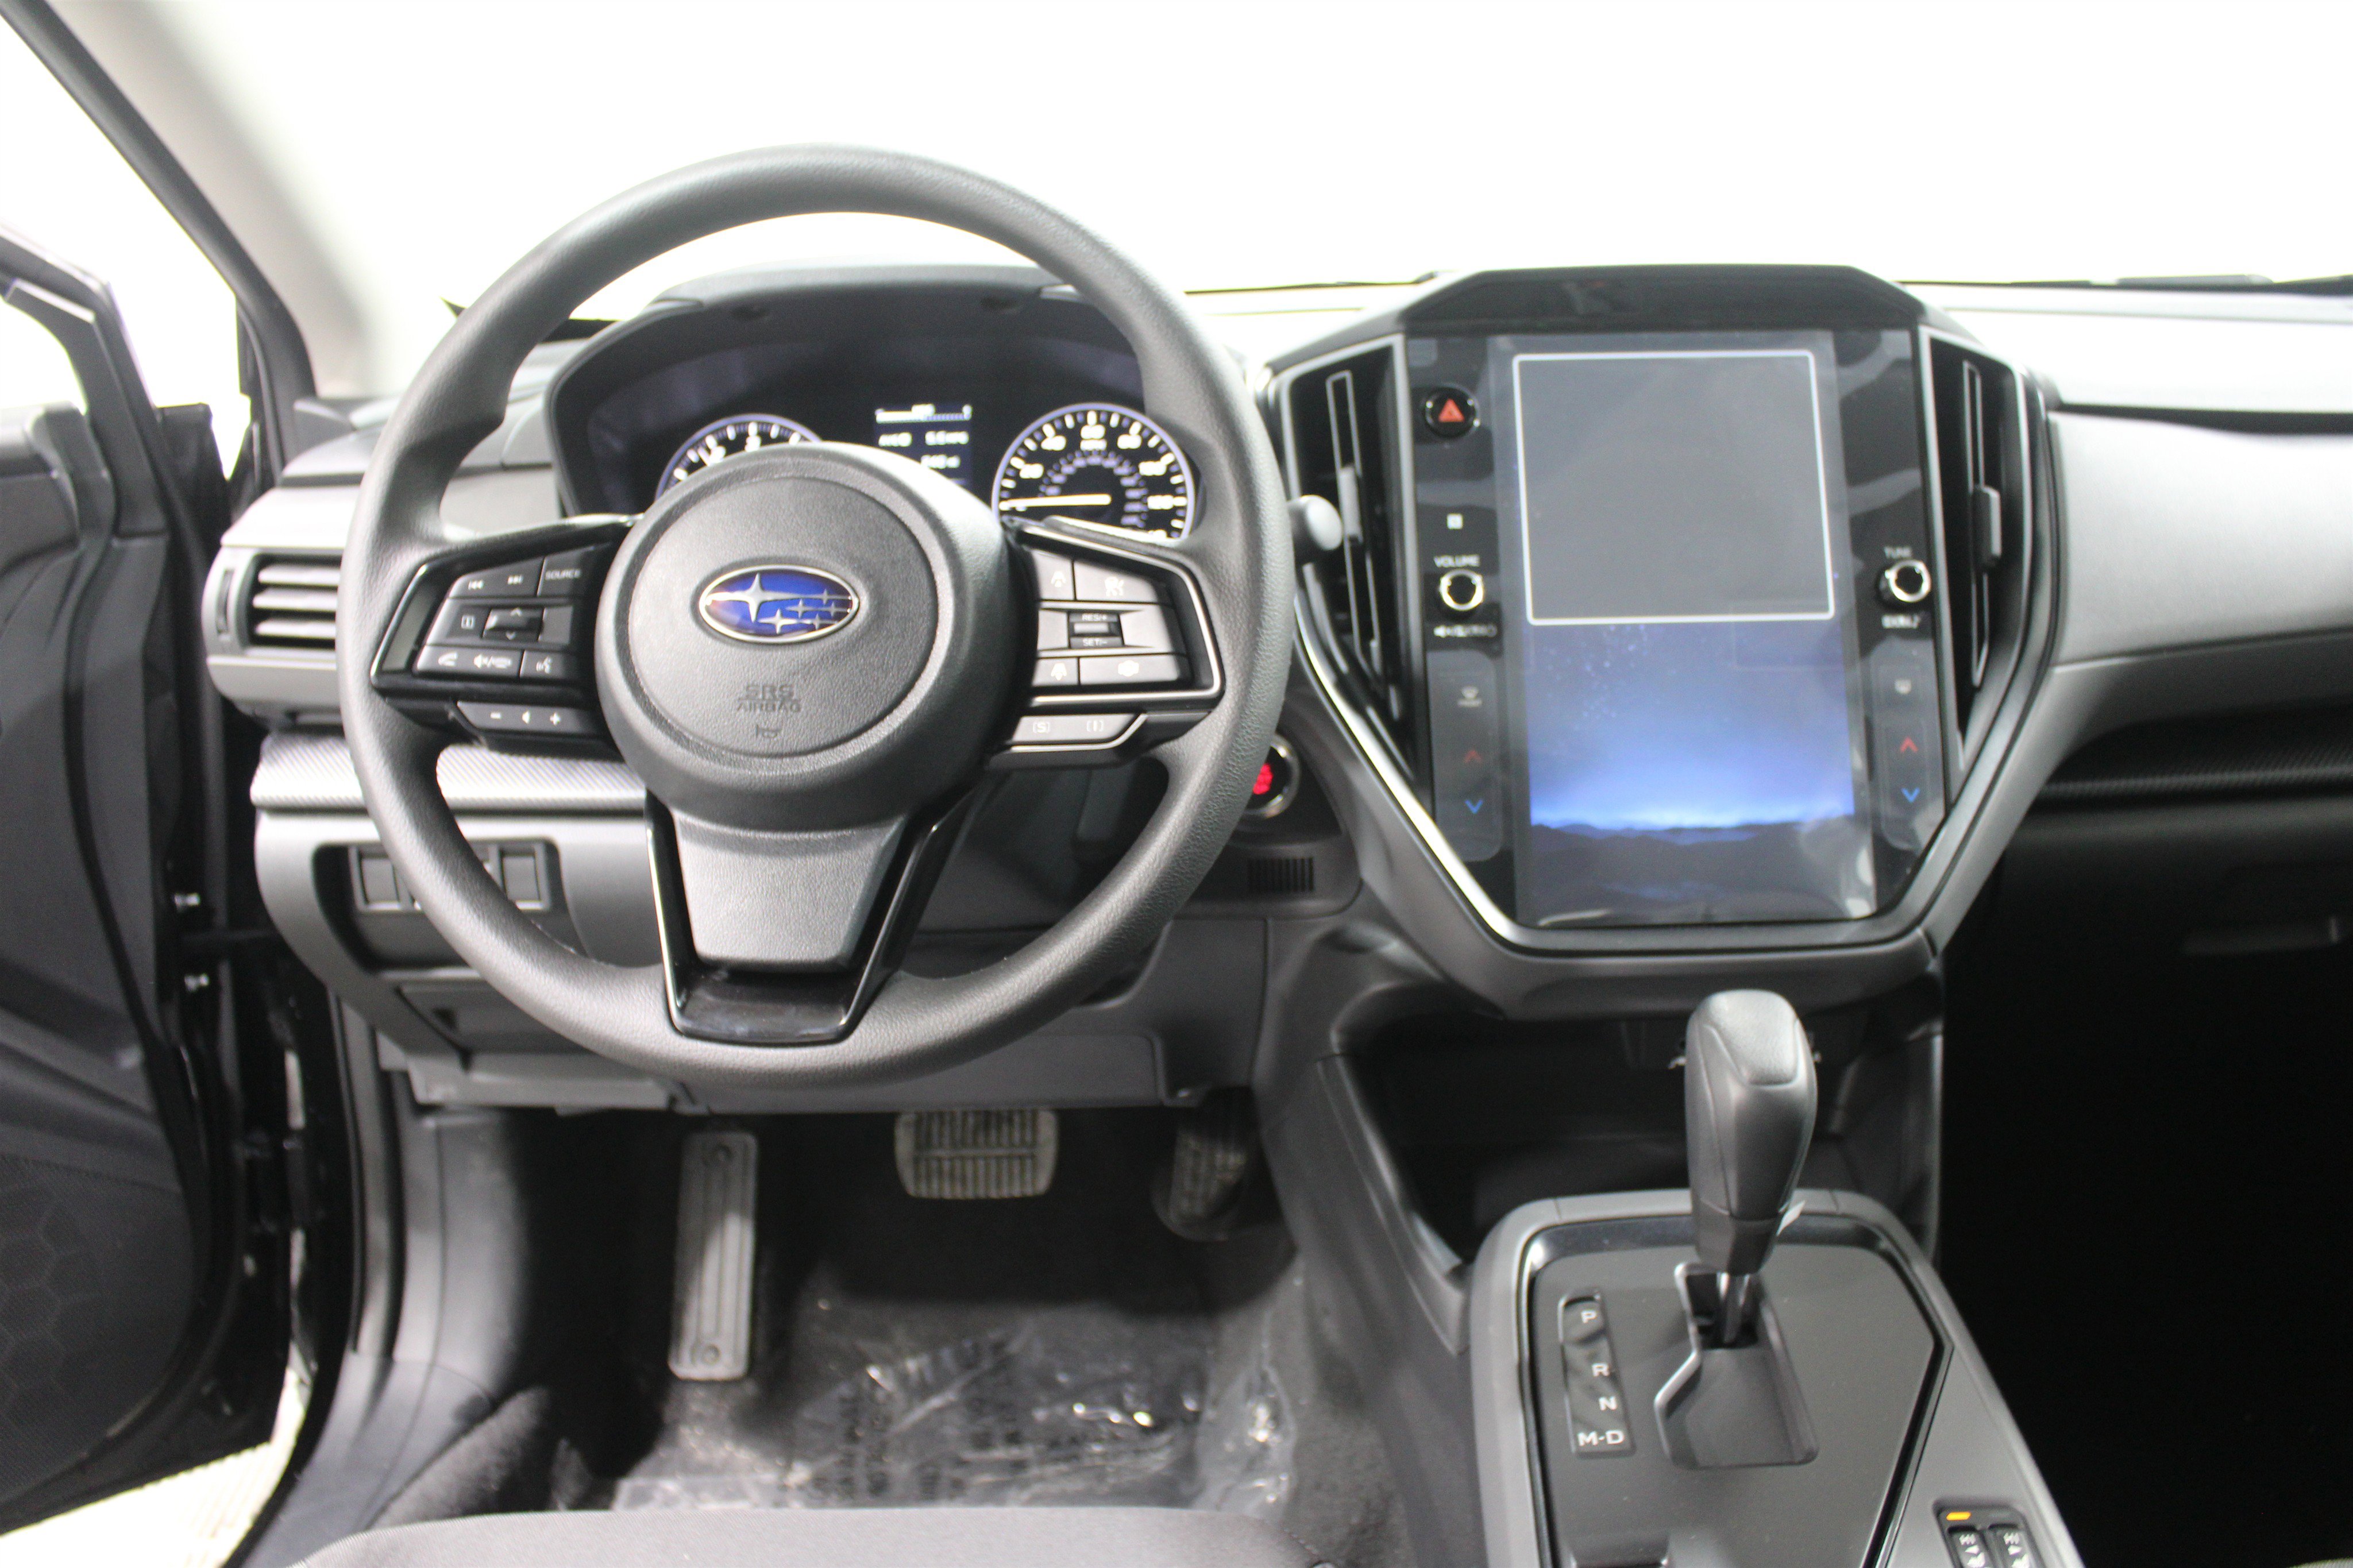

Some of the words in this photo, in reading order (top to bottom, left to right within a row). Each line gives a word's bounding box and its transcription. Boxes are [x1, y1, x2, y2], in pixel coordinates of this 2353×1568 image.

[1434, 554, 1480, 567] VOLUME
[545, 569, 581, 580] SOURCE
[1581, 1310, 1597, 1323] P
[1591, 1363, 1610, 1377] R
[1599, 1396, 1617, 1411] N
[1577, 1430, 1625, 1446] M-D
